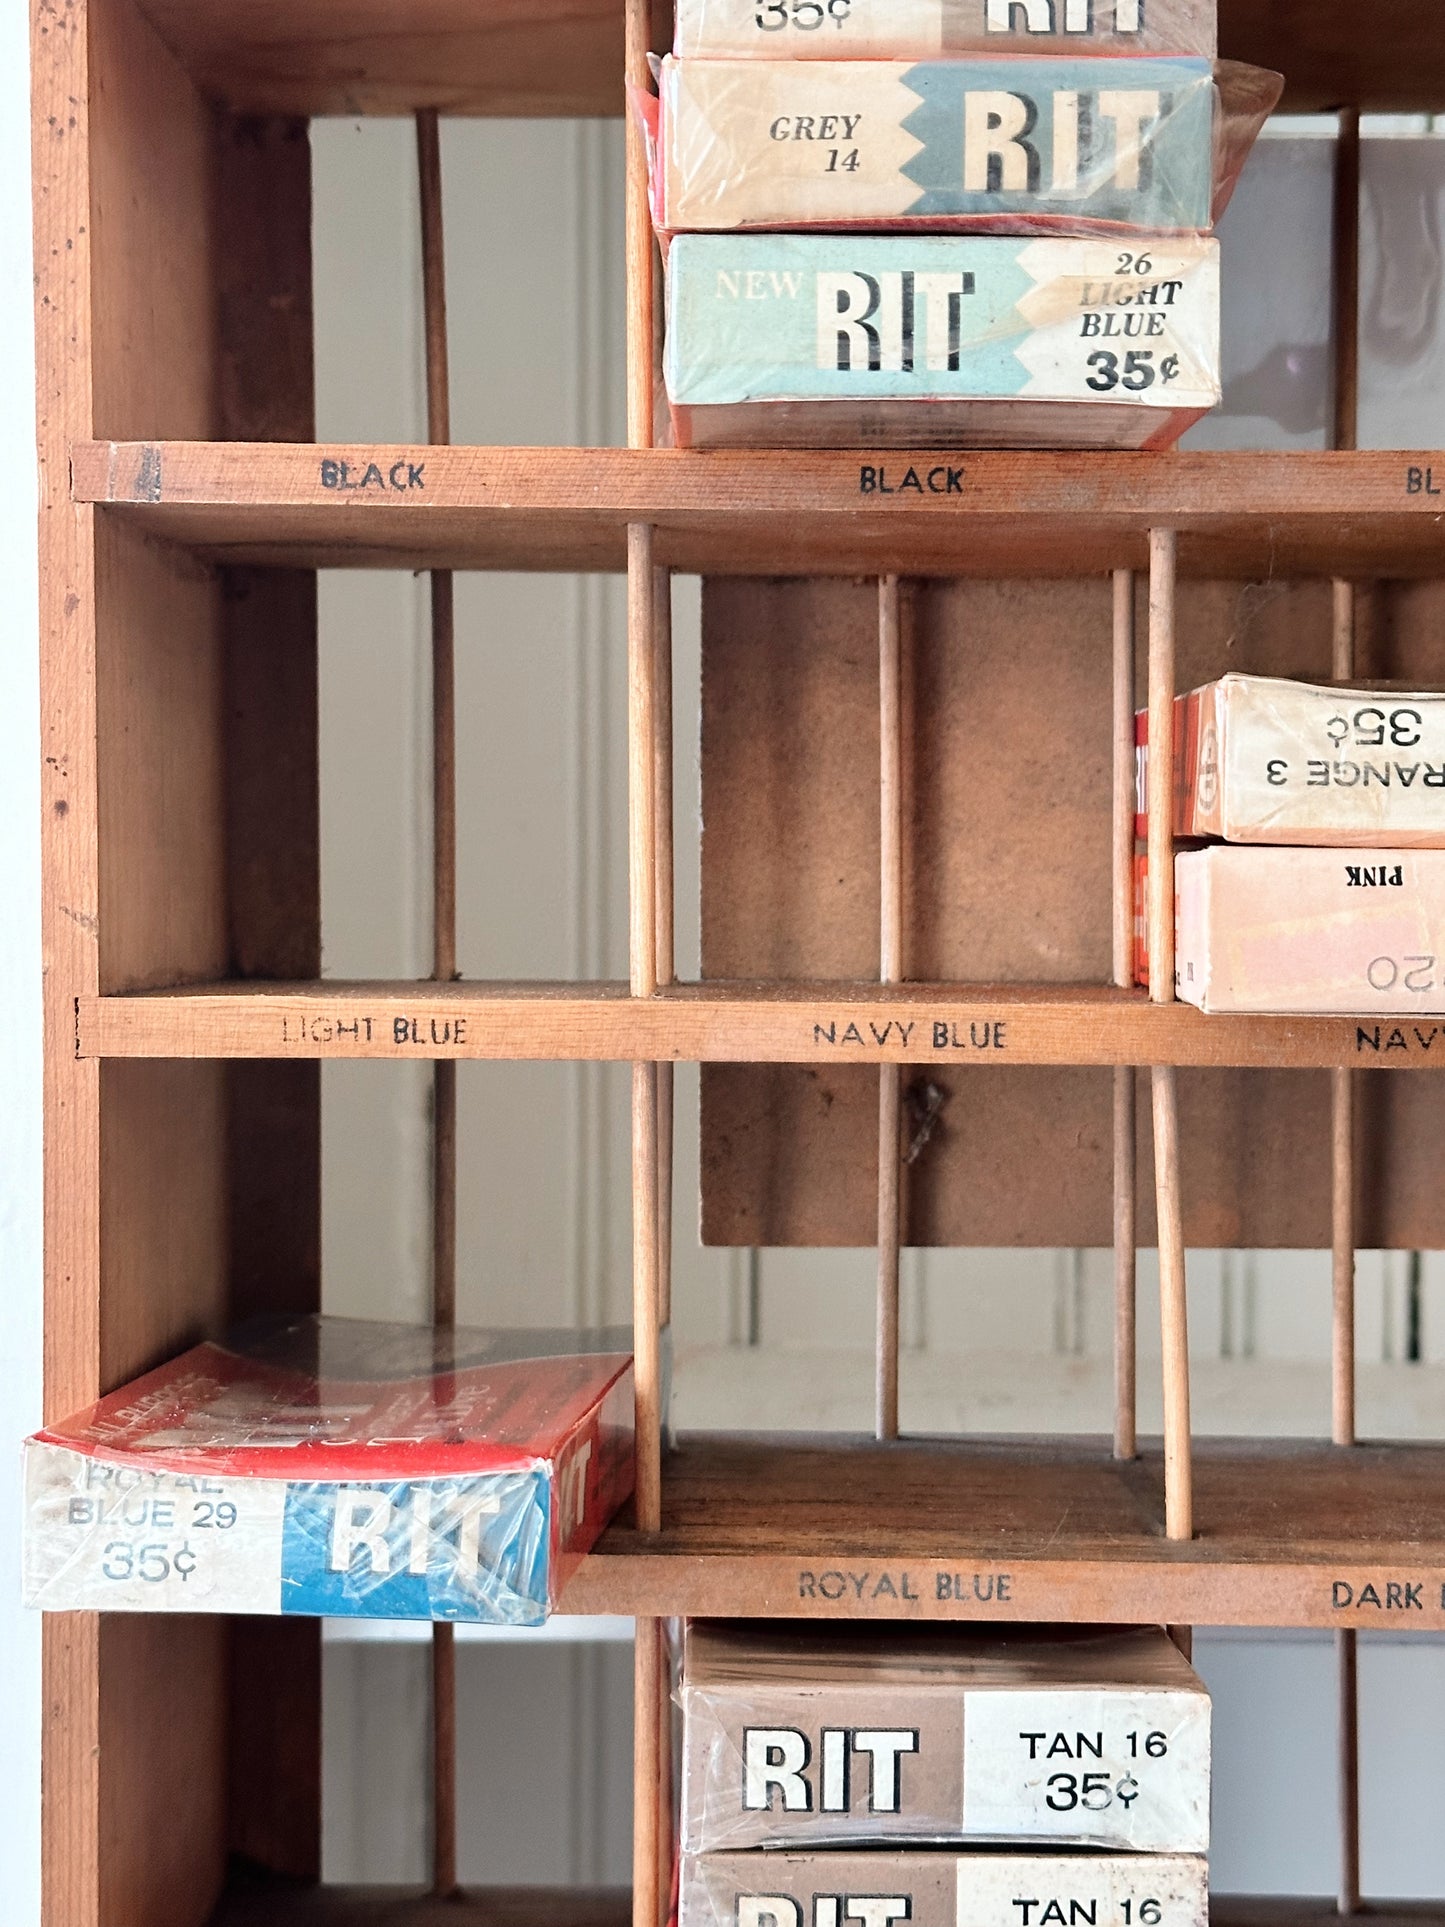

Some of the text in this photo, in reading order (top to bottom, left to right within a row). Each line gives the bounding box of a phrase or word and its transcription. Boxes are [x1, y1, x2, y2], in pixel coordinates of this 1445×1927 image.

[769, 113, 862, 142] GREY
[963, 89, 1174, 194] RIT
[824, 148, 861, 173] 14
[1114, 252, 1153, 275] 26
[1079, 280, 1184, 306] LIGHT
[715, 270, 976, 373] NEW RIT
[1079, 312, 1167, 338] BLUE
[1085, 350, 1180, 391] 35¢
[320, 458, 426, 490] BLACK
[859, 465, 966, 495] BLACK
[1405, 466, 1441, 495] BL
[1326, 707, 1423, 748] 35¢
[1266, 759, 1289, 786] 3
[1346, 865, 1404, 887] PINK
[1366, 954, 1436, 993] 20
[282, 1014, 468, 1045] LIGHT BLUE
[813, 1020, 1009, 1049] NAVY BLUE
[1356, 1025, 1445, 1052] NAV
[68, 1497, 238, 1529] BLUE 29
[326, 1485, 502, 1578] RIT
[102, 1540, 197, 1583] 35¢
[798, 1570, 1013, 1601] ROYAL BLUE
[1332, 1581, 1424, 1610] DARK
[1018, 1730, 1168, 1760] TAN 16
[741, 1725, 921, 1814] RIT
[1045, 1772, 1140, 1813] 35¢
[1011, 1897, 1163, 1927] TAN 16
